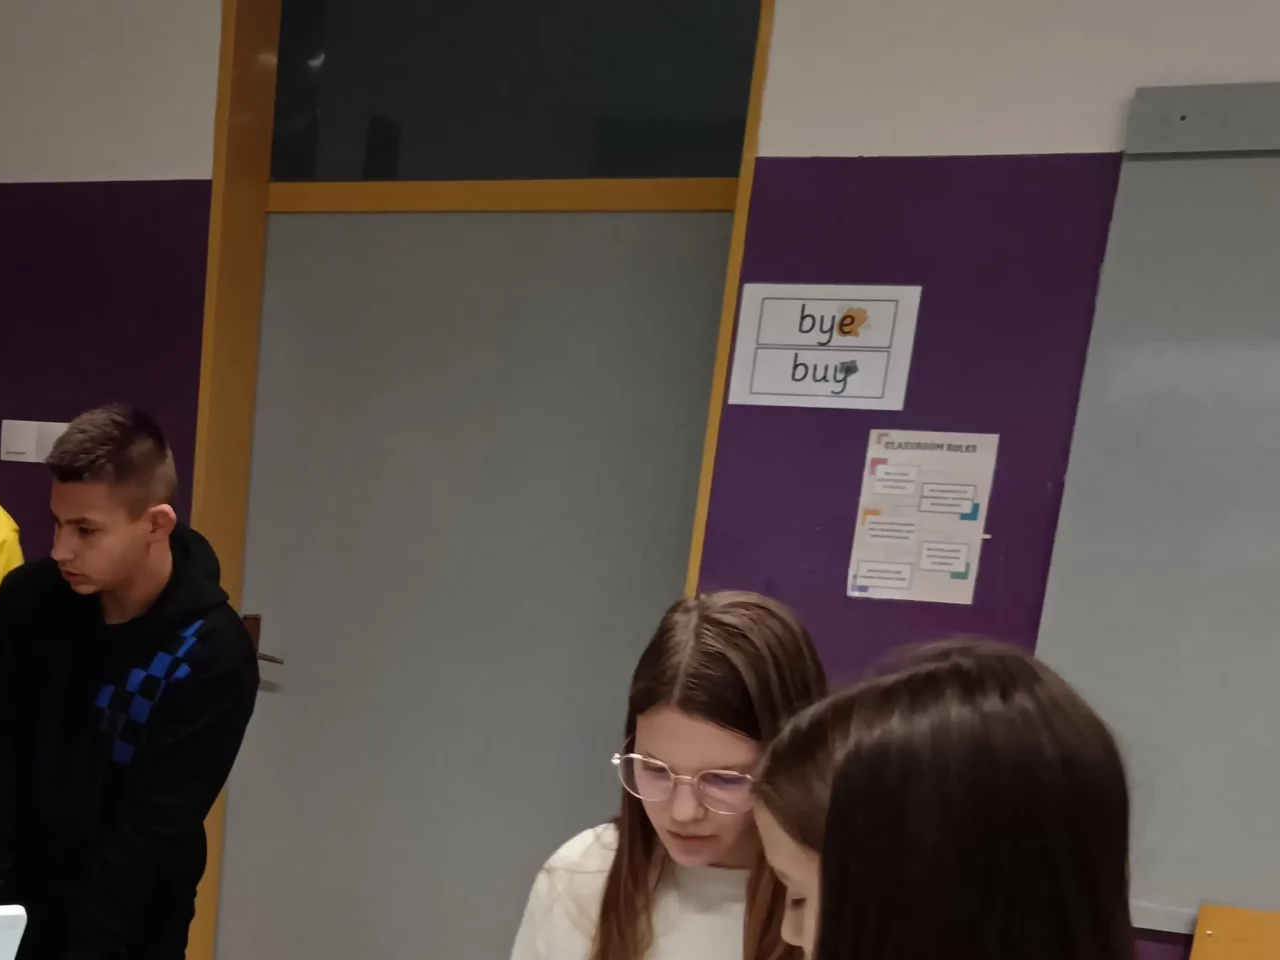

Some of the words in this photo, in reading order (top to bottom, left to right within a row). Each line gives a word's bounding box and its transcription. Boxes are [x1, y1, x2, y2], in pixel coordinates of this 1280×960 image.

[798, 303, 856, 346] bye
[791, 352, 850, 394] buy
[884, 441, 944, 452] CLASSROOM
[946, 443, 978, 454] RULES
